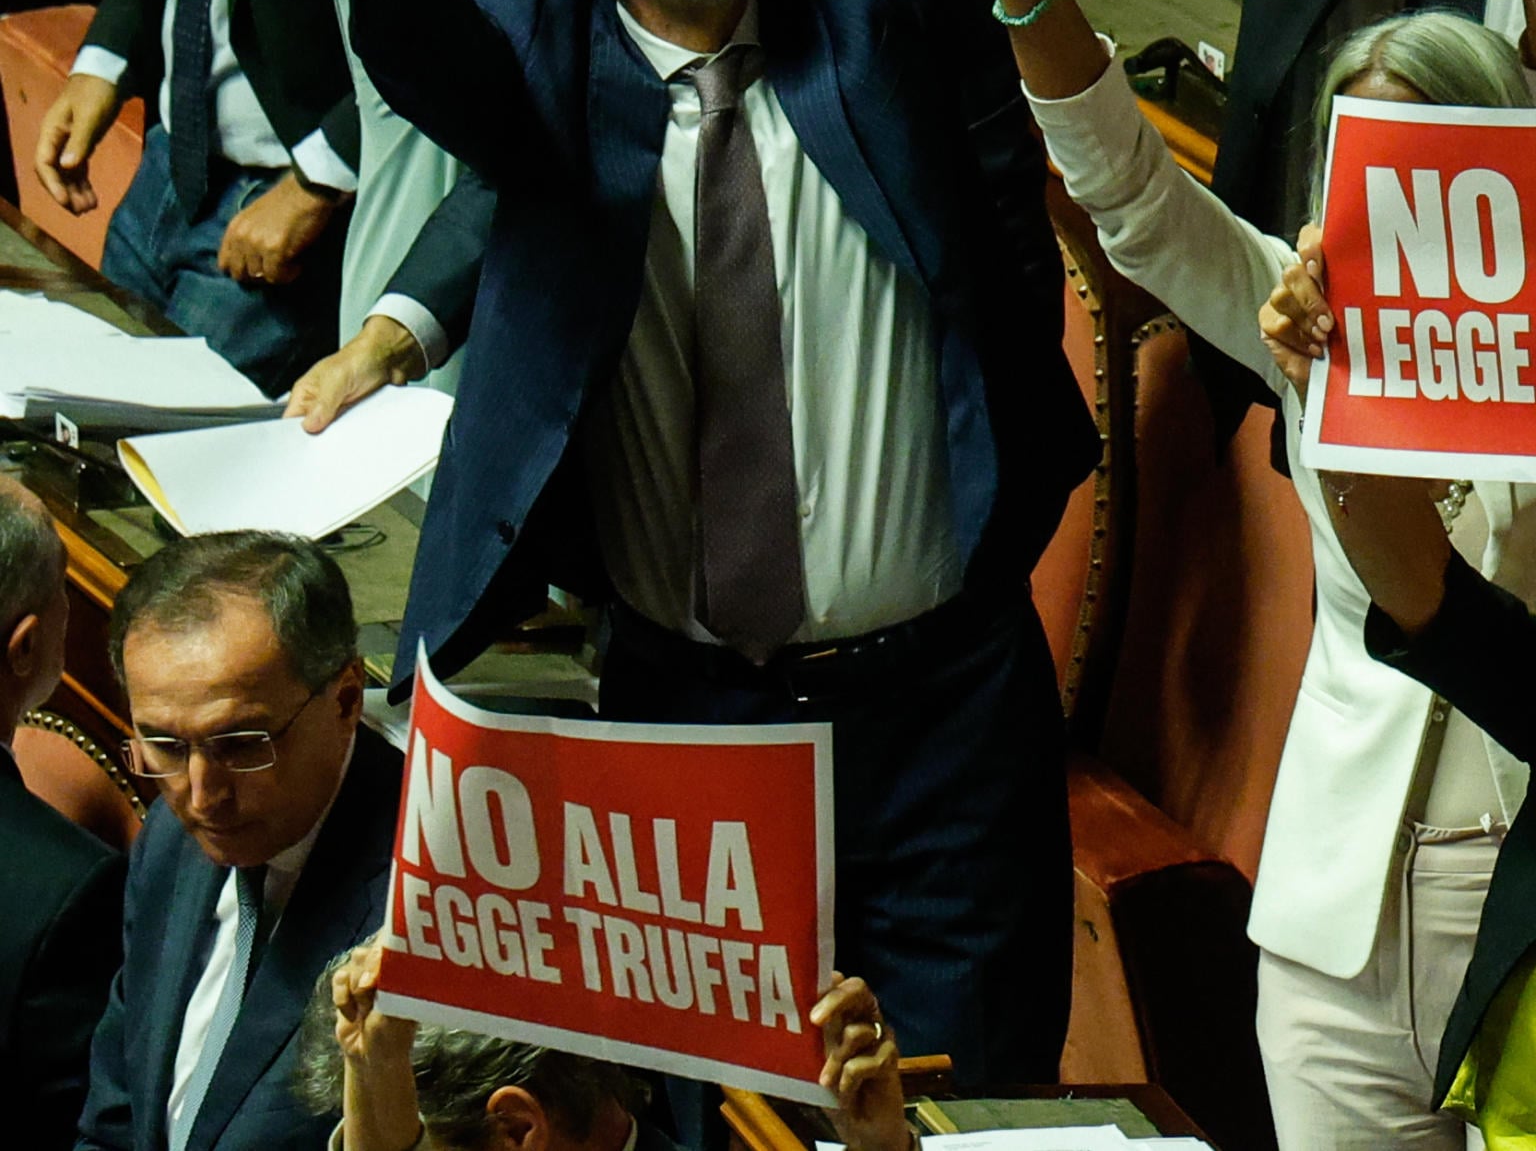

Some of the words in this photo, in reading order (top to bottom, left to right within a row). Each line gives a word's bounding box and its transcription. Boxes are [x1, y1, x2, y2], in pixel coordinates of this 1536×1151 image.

[1366, 166, 1526, 303] NO
[1344, 307, 1535, 404] LEGGE
[402, 727, 541, 890] NO
[563, 801, 763, 931] ALLA
[382, 858, 562, 984] LEGGE
[563, 906, 802, 1034] TRUFFA
